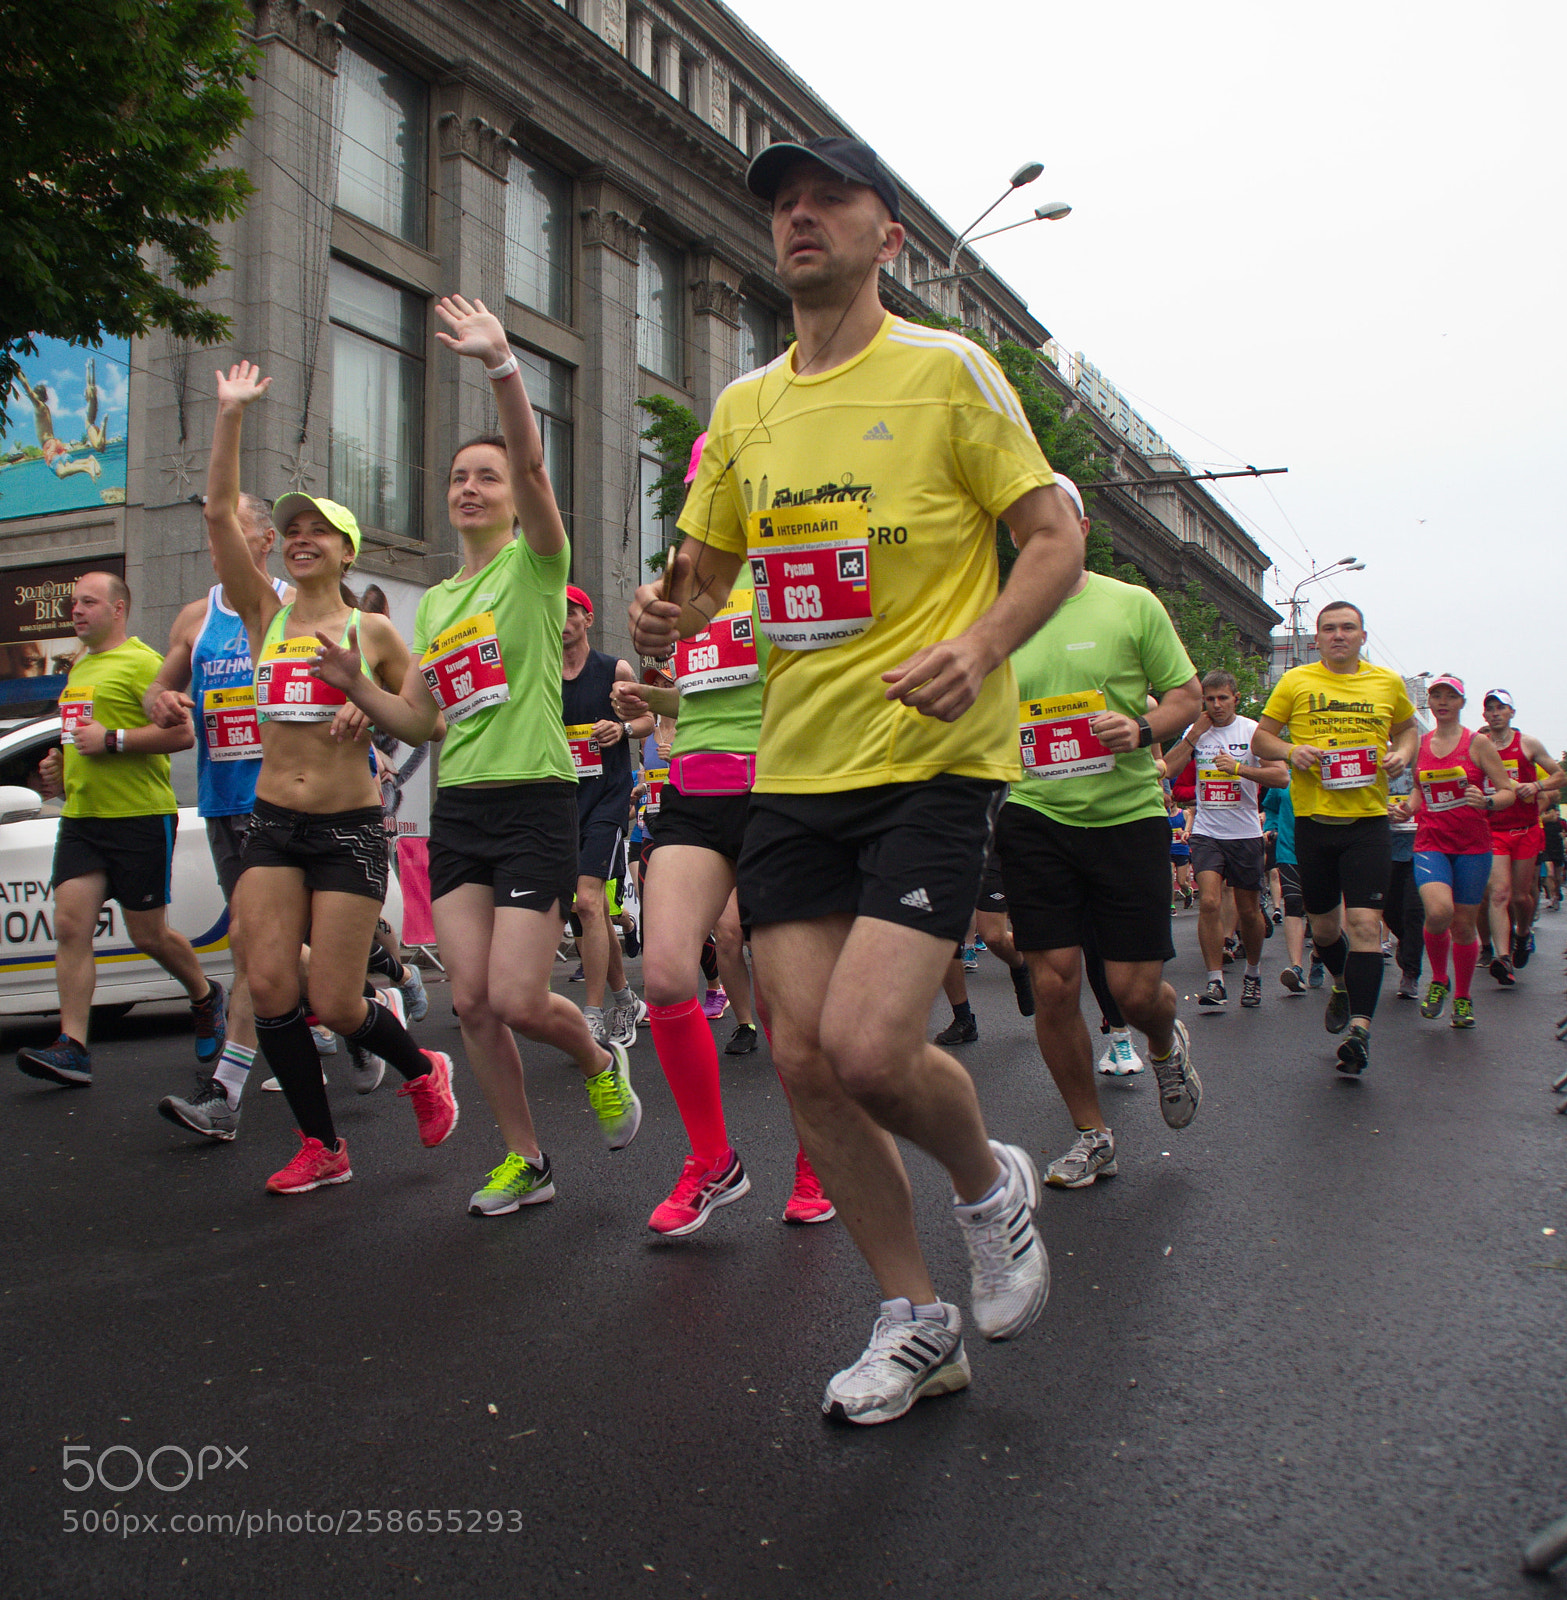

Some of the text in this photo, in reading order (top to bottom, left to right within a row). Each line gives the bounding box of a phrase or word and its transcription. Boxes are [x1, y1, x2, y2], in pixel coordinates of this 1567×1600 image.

[862, 433, 893, 441] adidas
[777, 519, 839, 537] ІНТЕРПАЙП
[783, 562, 815, 579] Руслан
[783, 584, 823, 620] 633
[441, 625, 478, 649] ІНТЕРПАЙП
[779, 628, 865, 642] UNDER ARMOUR
[688, 644, 720, 672] 559
[450, 670, 476, 700] 562
[706, 673, 750, 684] ARMOUR
[284, 681, 312, 703] 561
[1045, 701, 1089, 715] ІНТЕРПАЙП
[1309, 716, 1354, 726] INTERPIPE
[227, 725, 254, 745] 554
[1052, 726, 1073, 738] Тарас
[1314, 727, 1332, 735] Half
[1049, 738, 1082, 762] 560
[1025, 756, 1035, 765] 59
[1041, 762, 1107, 778] UNDER ARMOUR
[1340, 762, 1362, 777] 588
[1210, 790, 1226, 801] 345
[383, 816, 417, 834] 00 грн
